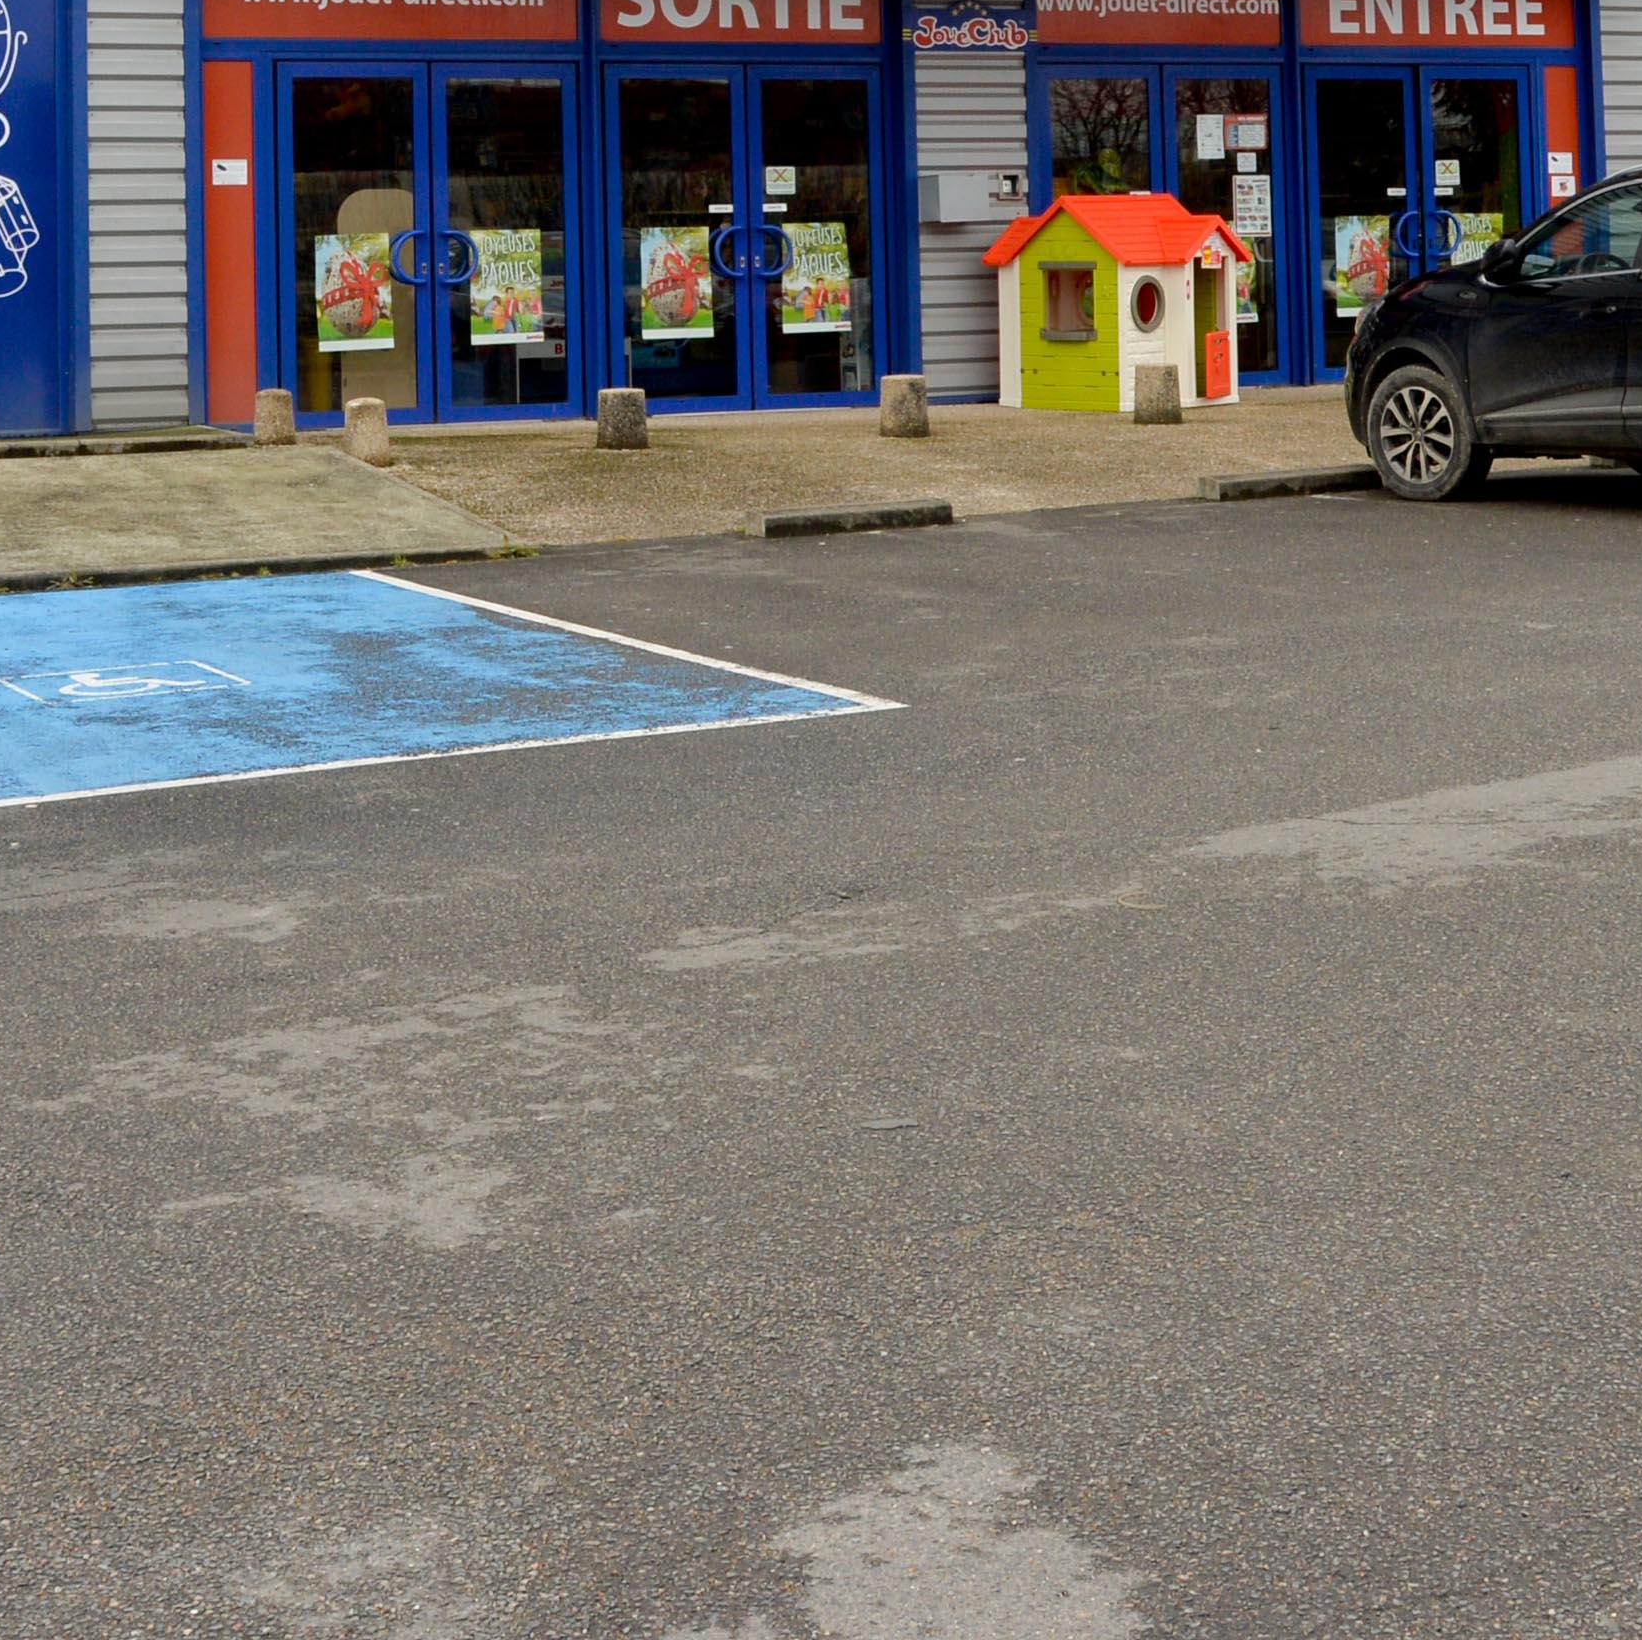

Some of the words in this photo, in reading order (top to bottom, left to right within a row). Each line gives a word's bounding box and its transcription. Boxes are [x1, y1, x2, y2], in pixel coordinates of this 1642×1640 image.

[913, 16, 1028, 49] JouéClub
[480, 233, 536, 256] JOYEUSES
[481, 258, 535, 287] PÂQUES
